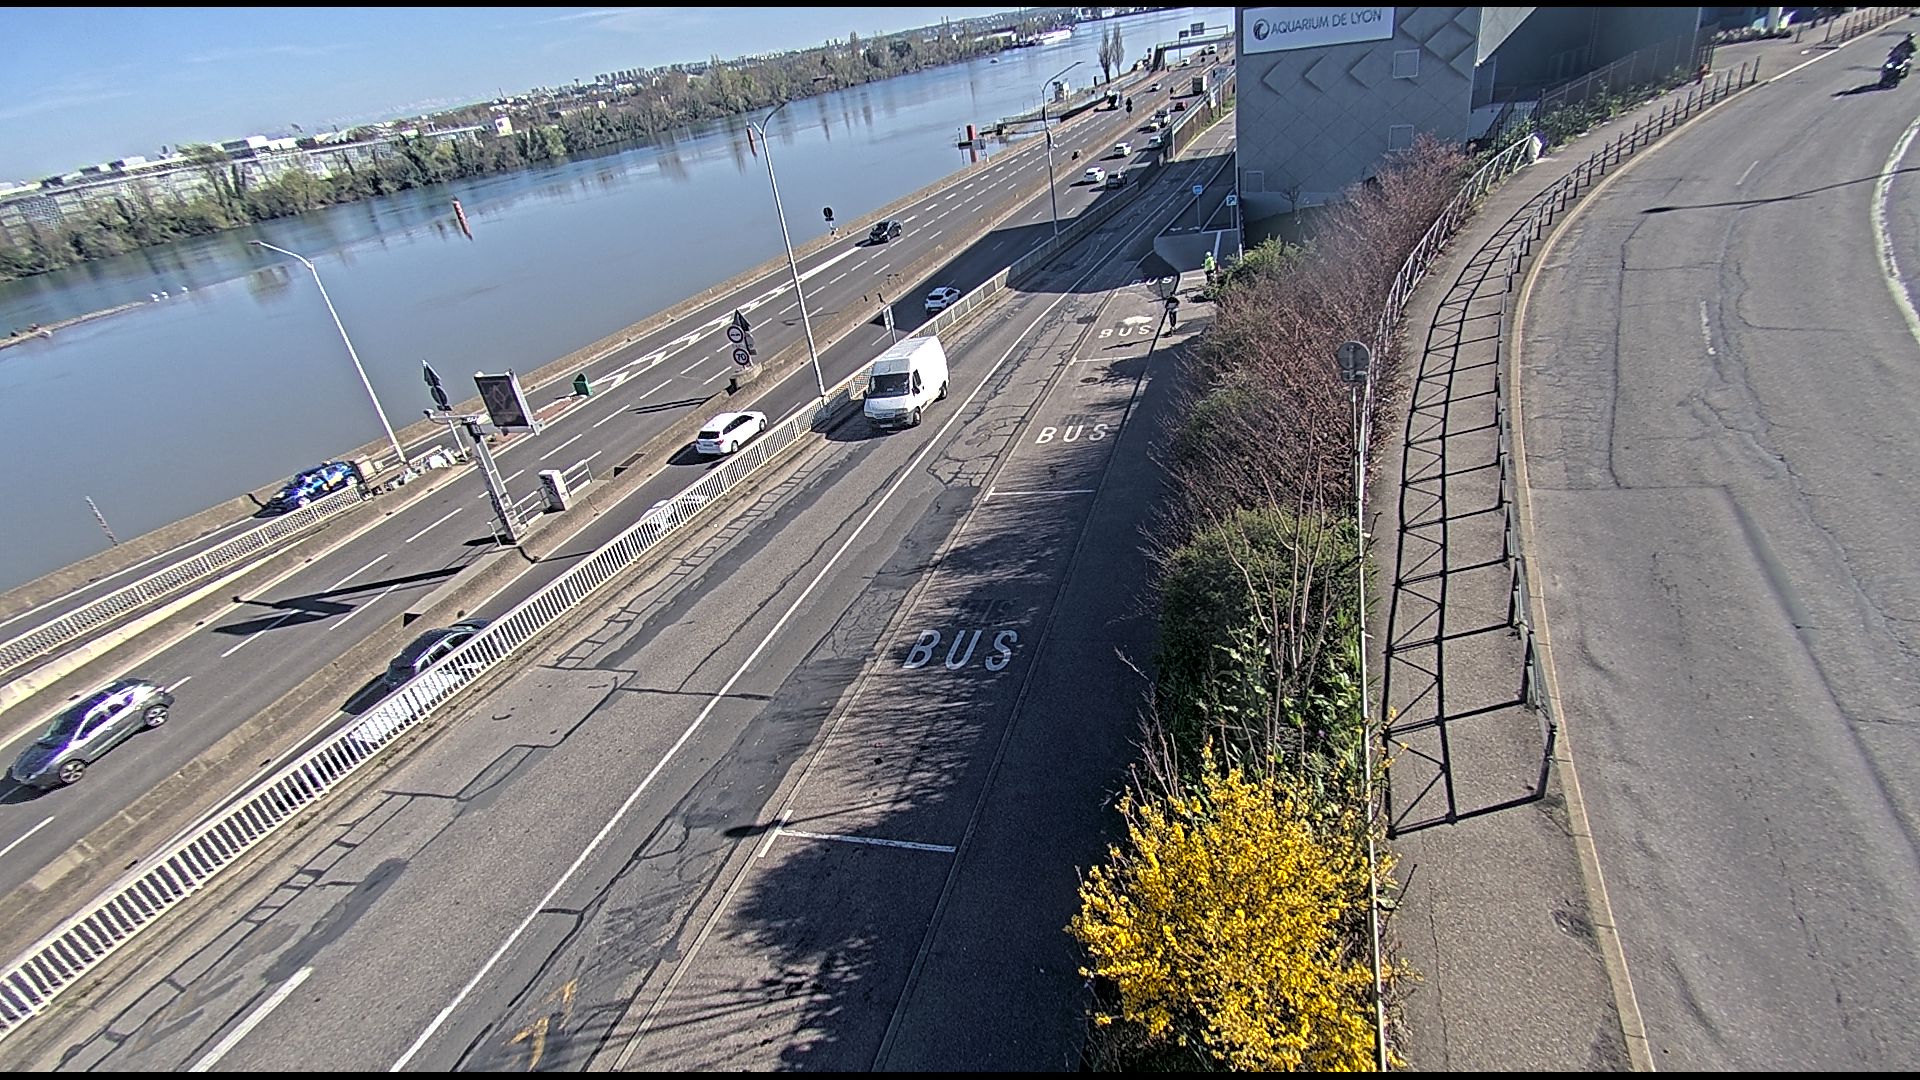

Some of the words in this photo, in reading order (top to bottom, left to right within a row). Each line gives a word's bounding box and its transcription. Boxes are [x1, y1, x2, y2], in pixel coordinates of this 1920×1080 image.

[1270, 16, 1329, 35] AQUARIUM
[1332, 13, 1347, 28] DE
[1351, 9, 1382, 25] LYON
[1098, 325, 1152, 339] BUS
[736, 353, 747, 361] 70
[1035, 424, 1109, 444] BUS
[902, 629, 1018, 671] BUS
